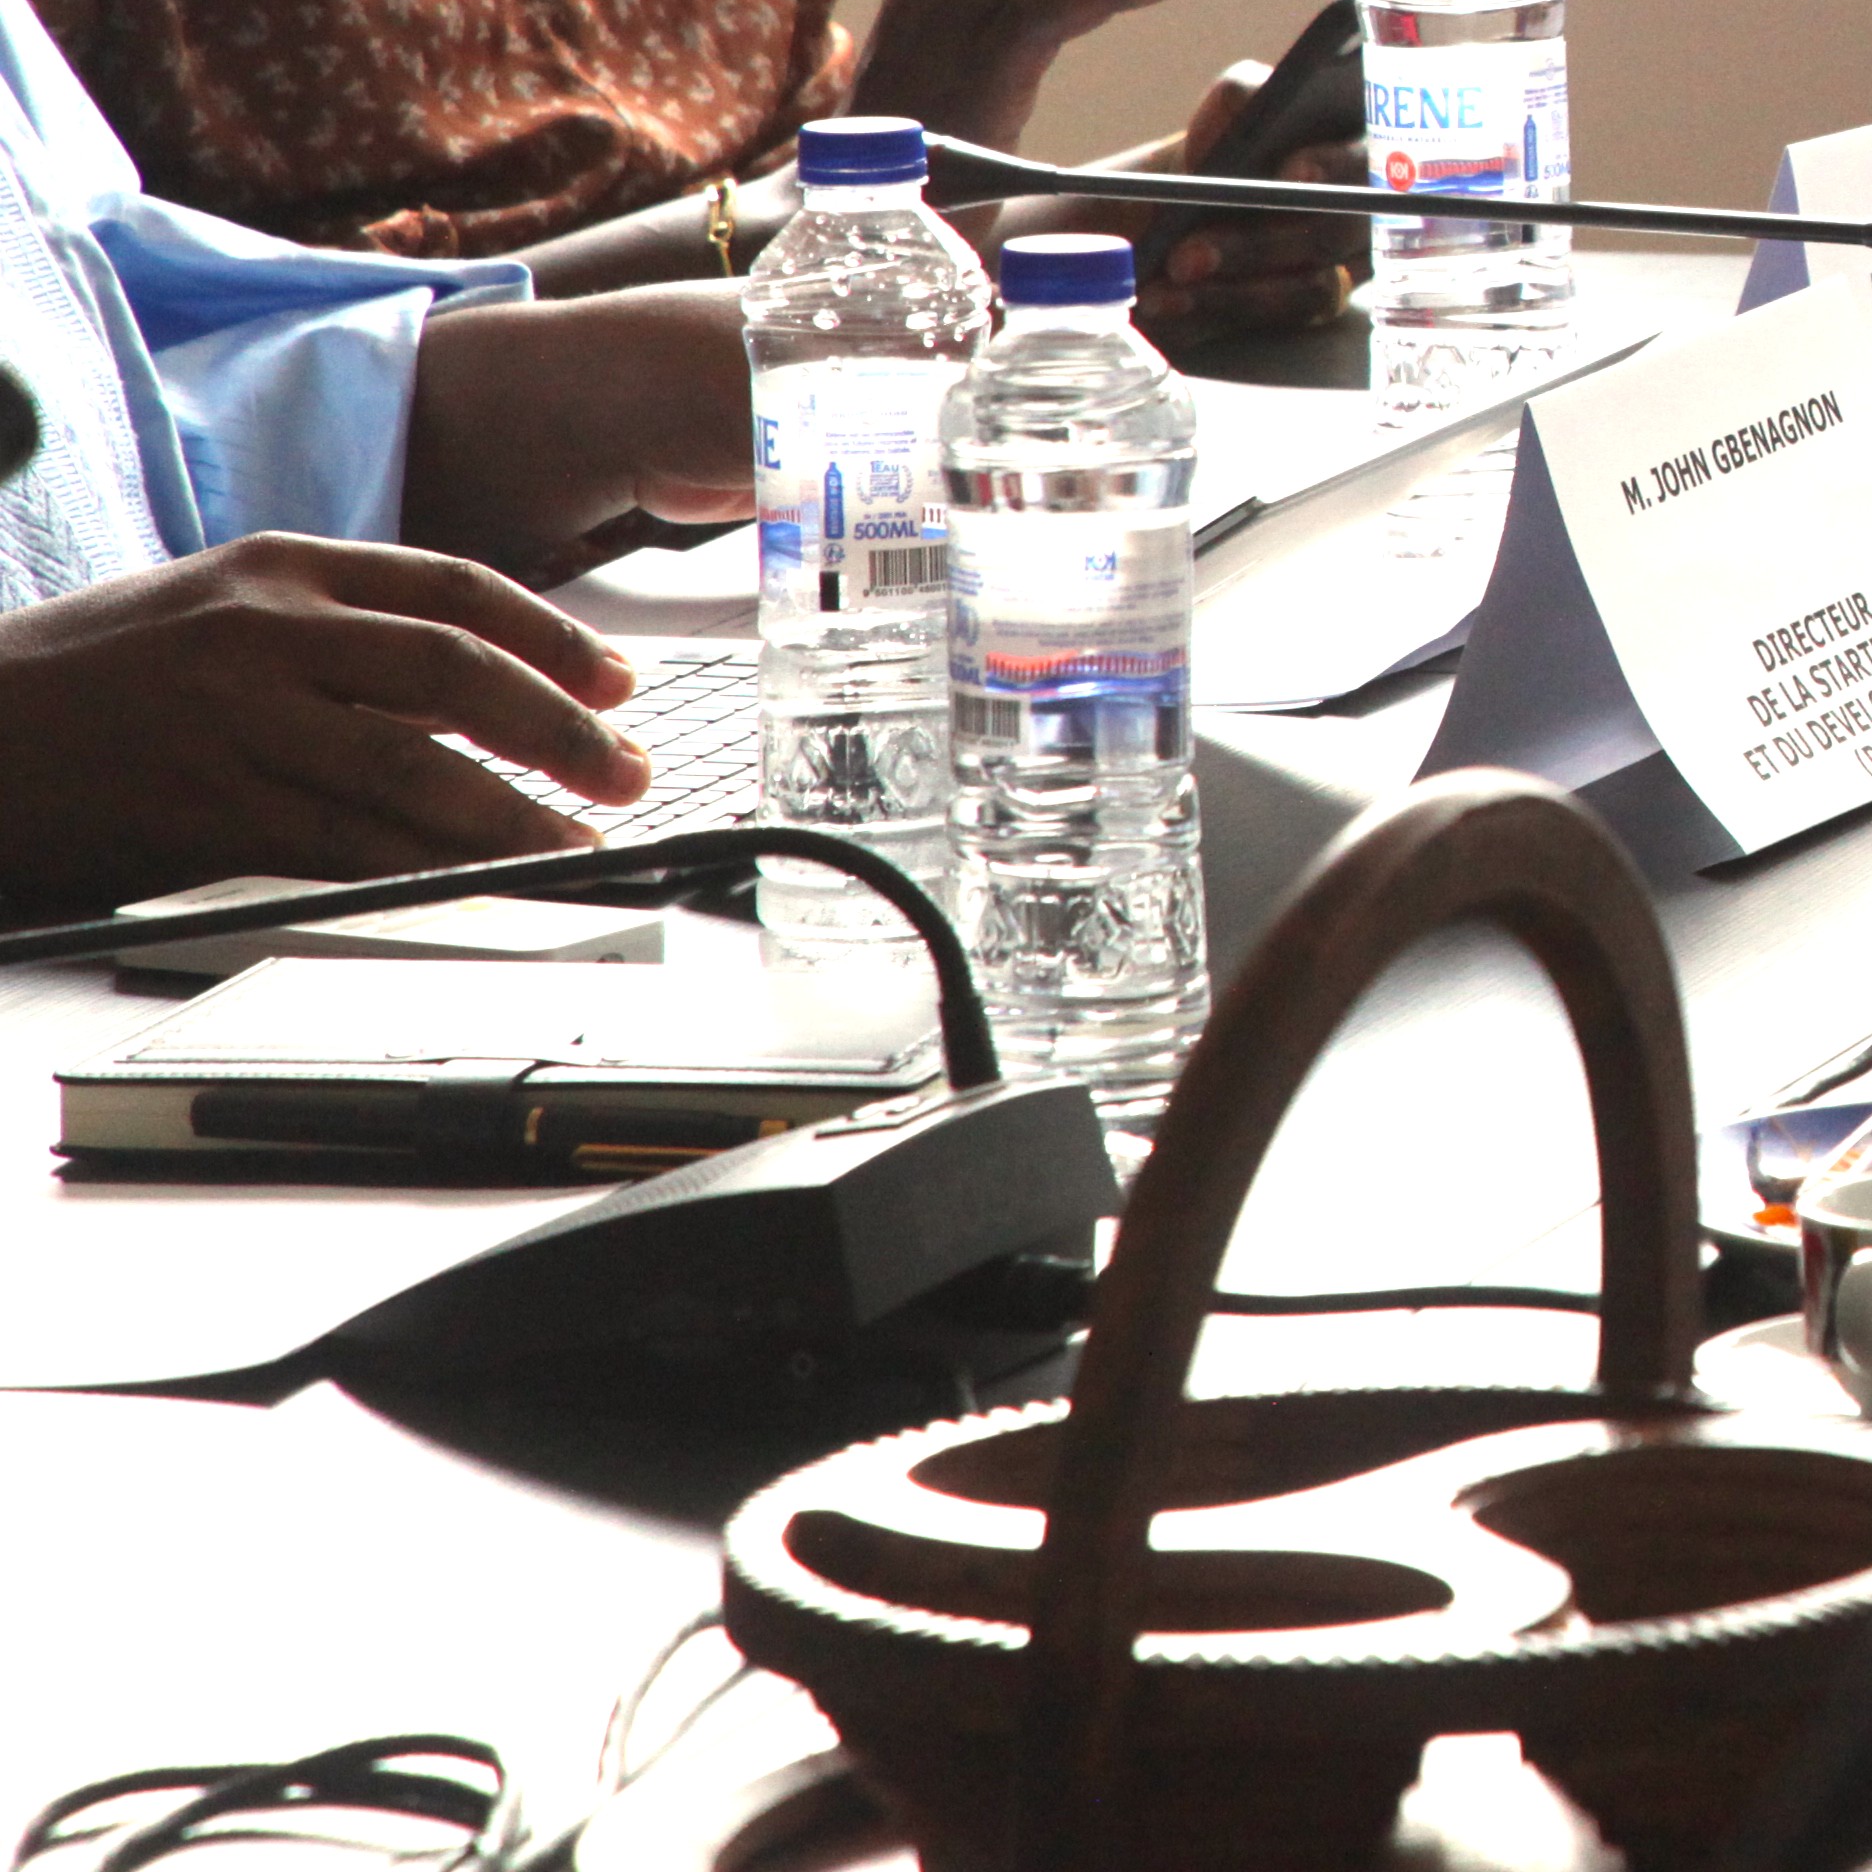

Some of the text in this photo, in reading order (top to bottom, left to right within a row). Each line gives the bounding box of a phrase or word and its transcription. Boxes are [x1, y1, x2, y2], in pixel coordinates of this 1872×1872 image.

[1620, 390, 1844, 515] M. JOHN GBENAGNON
[853, 520, 919, 541] 500ML
[1746, 687, 1788, 728] DE
[1780, 675, 1818, 713] LA
[1743, 745, 1780, 781] ET
[1773, 728, 1814, 768] DU
